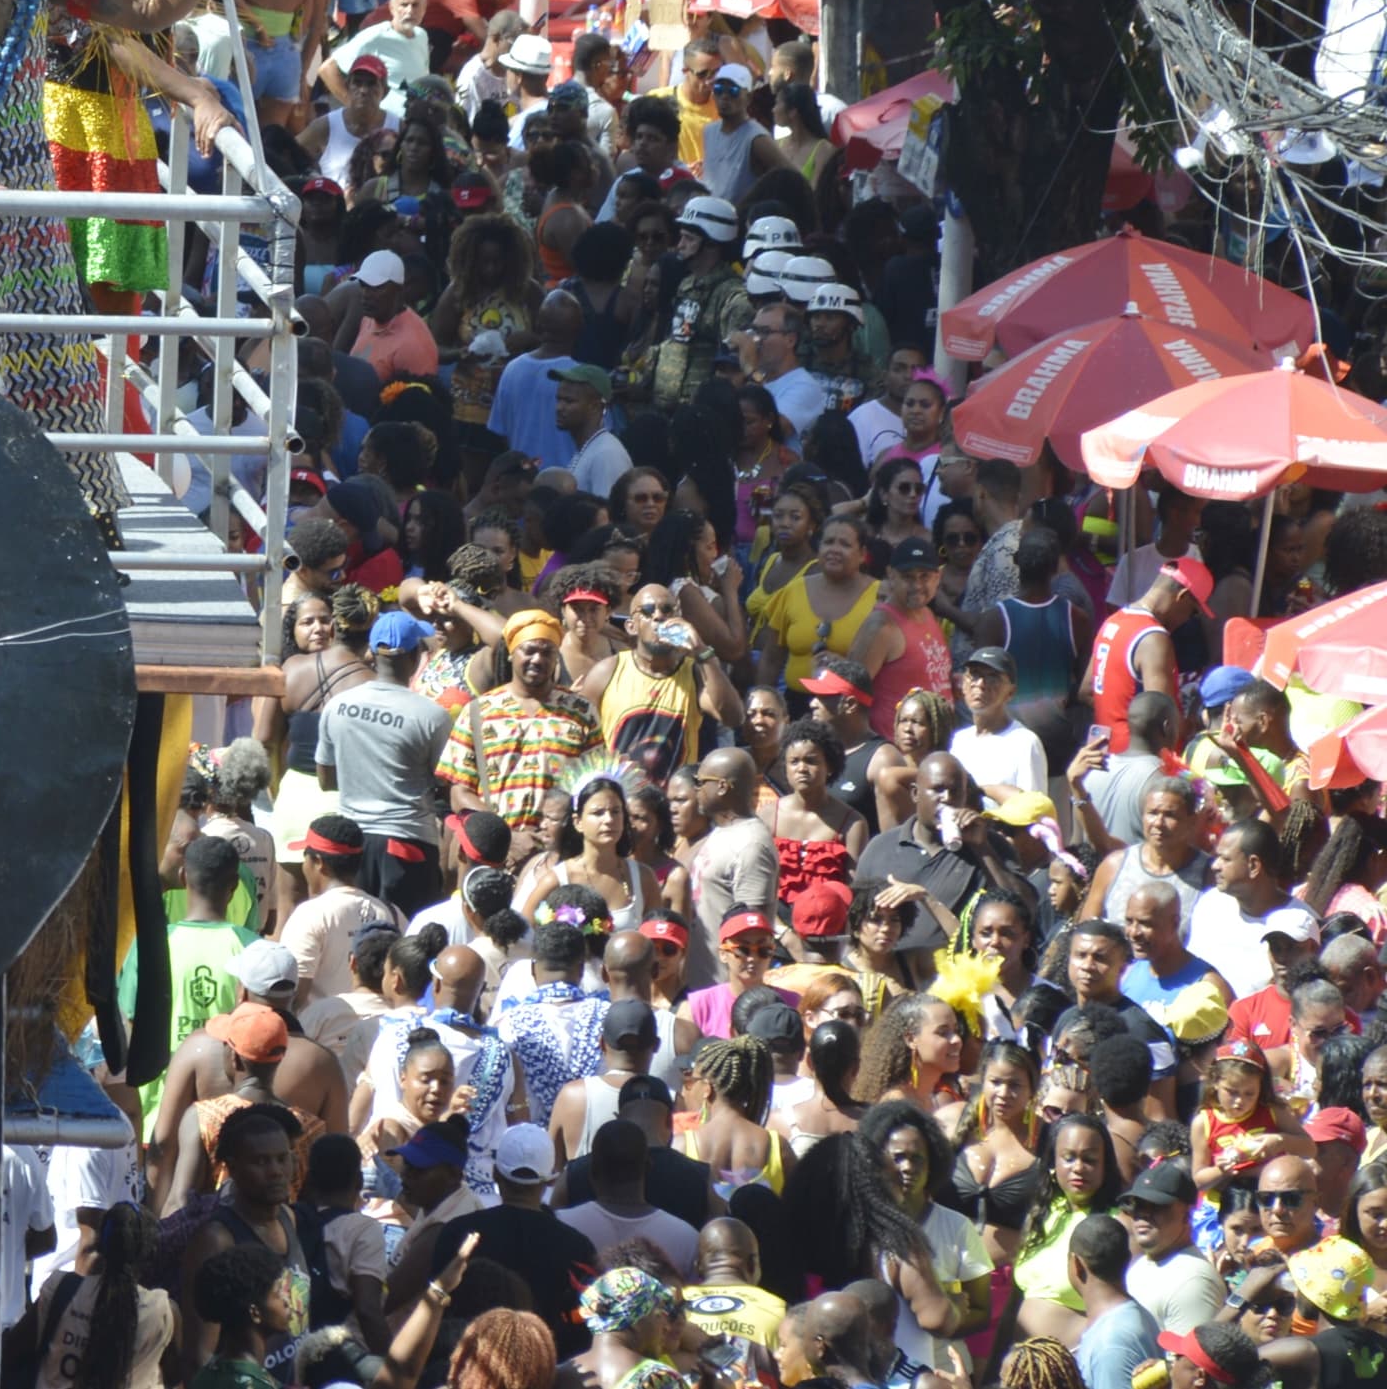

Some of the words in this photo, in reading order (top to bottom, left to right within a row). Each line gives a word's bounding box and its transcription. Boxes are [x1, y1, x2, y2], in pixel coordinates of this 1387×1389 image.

[978, 255, 1076, 318] BRAHMA
[1005, 338, 1092, 420] BRAHMA
[337, 703, 405, 730] ROBSON
